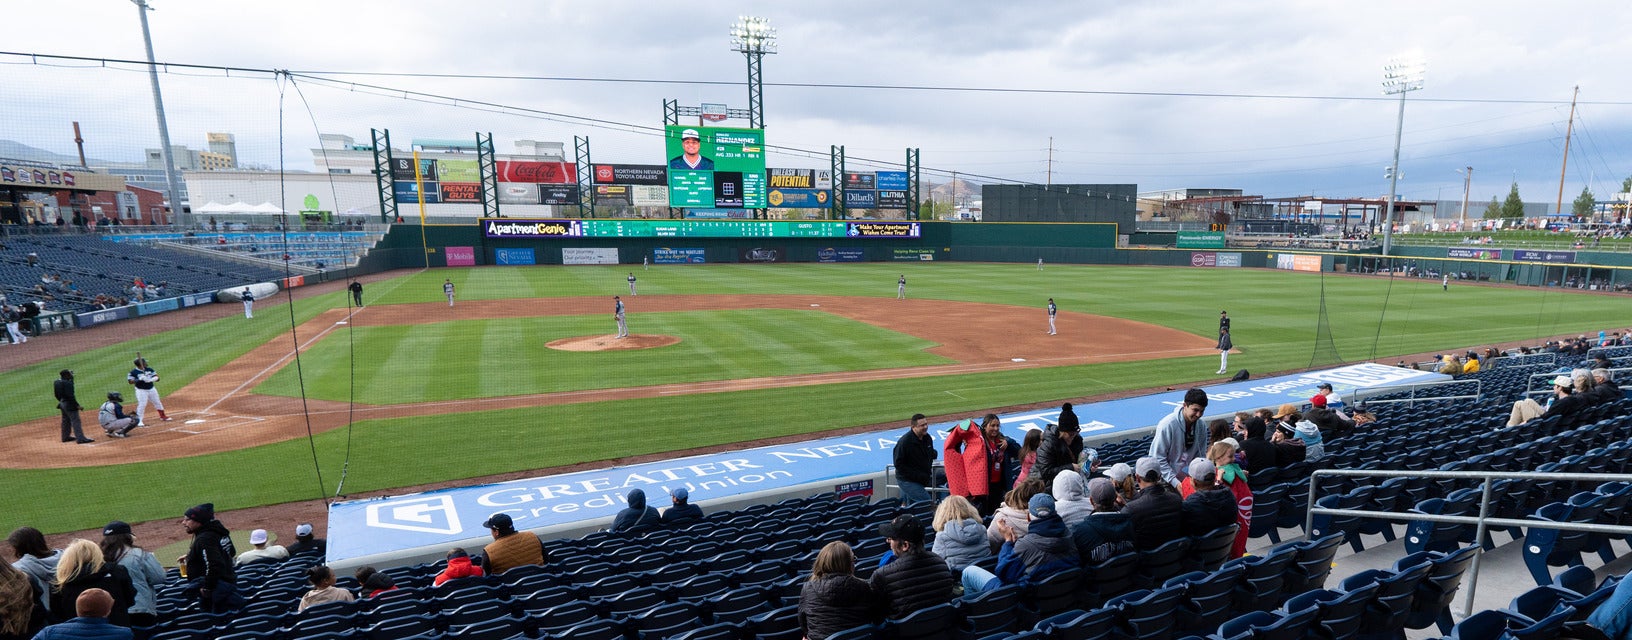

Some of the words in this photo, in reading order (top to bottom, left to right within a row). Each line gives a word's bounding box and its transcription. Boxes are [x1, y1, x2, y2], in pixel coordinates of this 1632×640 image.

[770, 176, 810, 187] POTENTIAL
[846, 193, 874, 201] Dillard's
[1250, 377, 1323, 394] game
[476, 458, 764, 508] GREATER
[766, 429, 956, 464] NEVAA
[489, 492, 640, 522] Credi
[662, 470, 793, 496] Union
